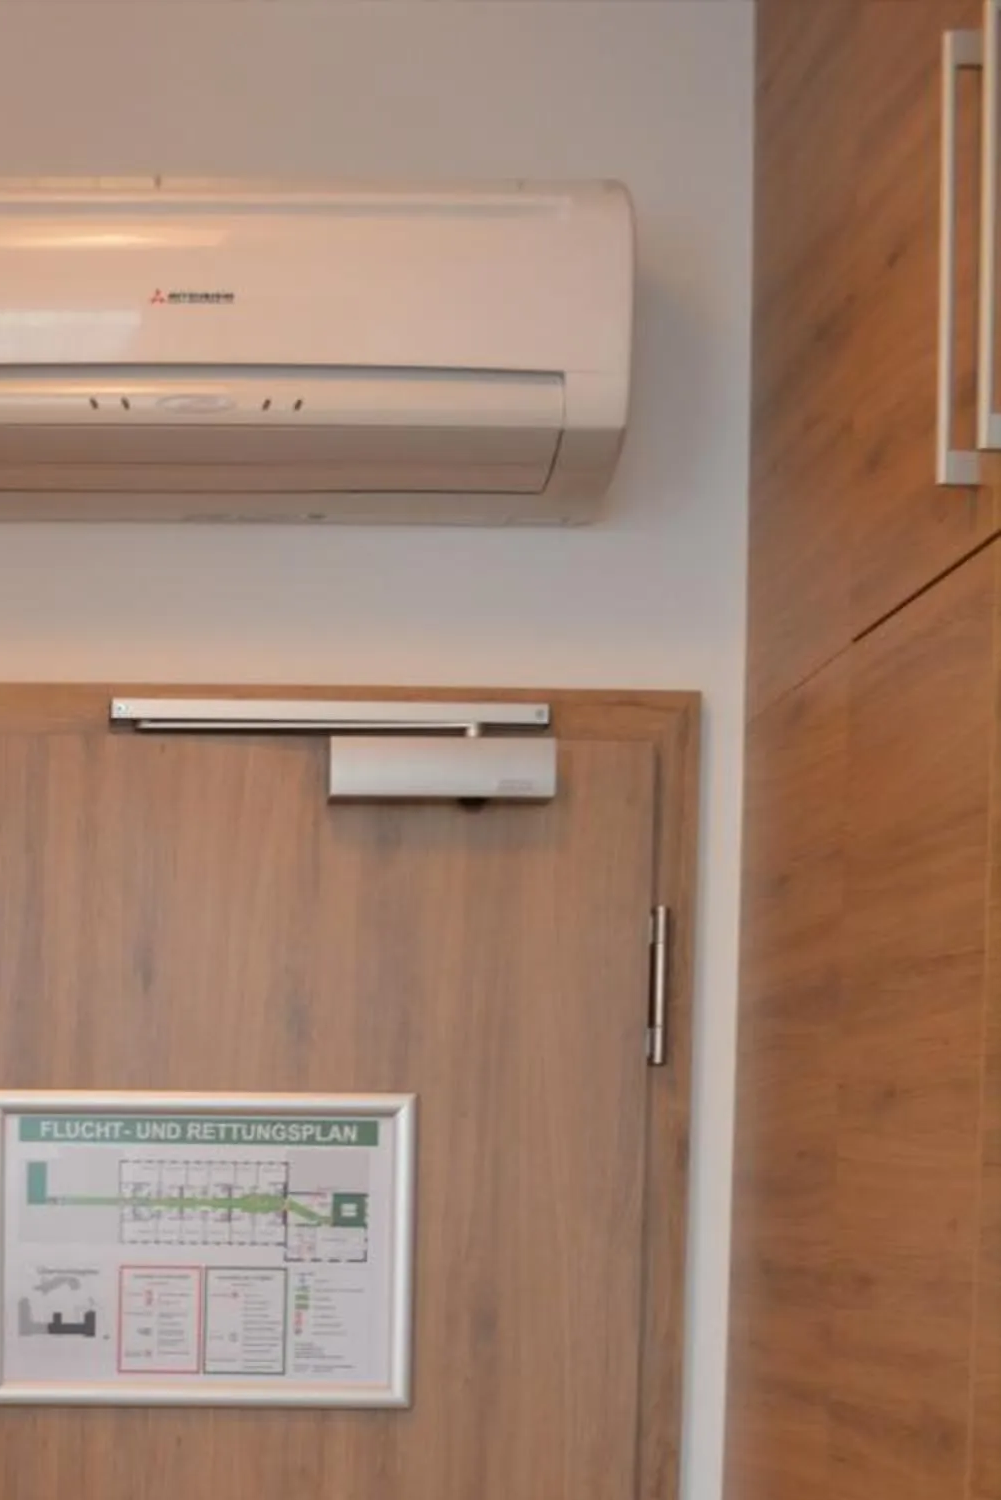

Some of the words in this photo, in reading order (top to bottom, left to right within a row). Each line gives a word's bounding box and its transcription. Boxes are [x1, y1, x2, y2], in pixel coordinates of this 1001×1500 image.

[39, 1120, 131, 1140] FLUCHT-
[136, 1121, 182, 1140] UND
[186, 1122, 358, 1143] RETTUNGSPLAN
